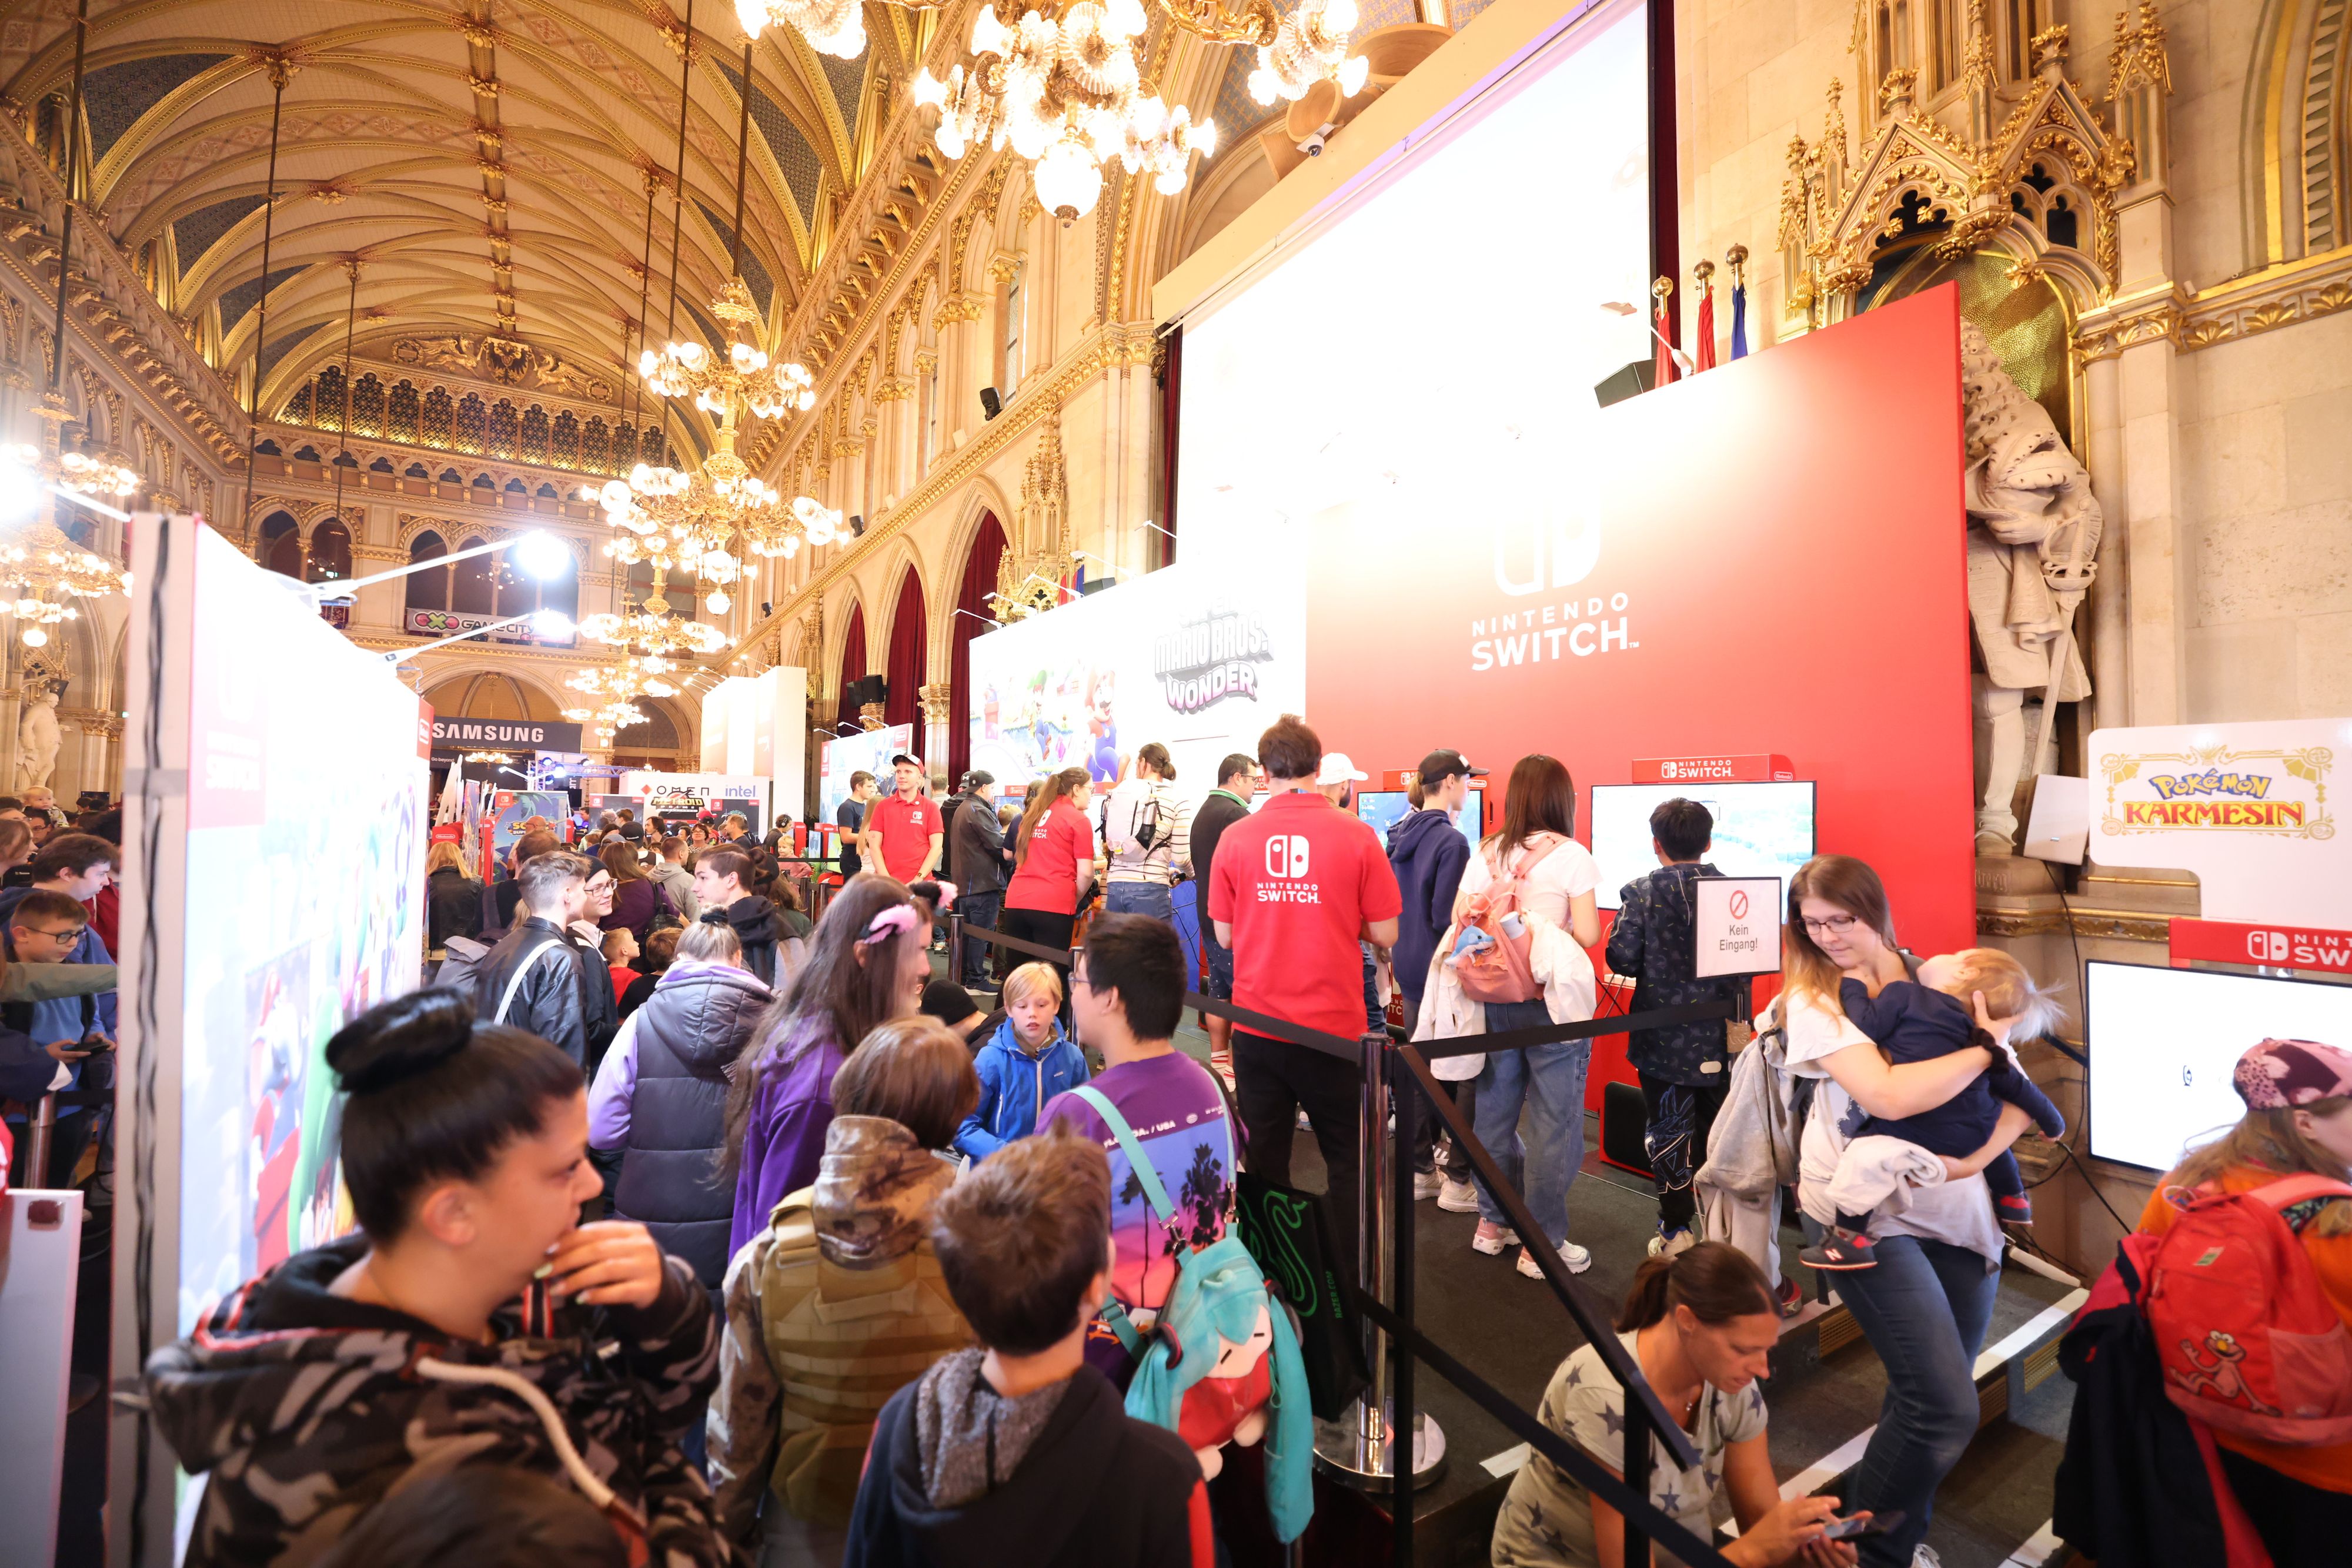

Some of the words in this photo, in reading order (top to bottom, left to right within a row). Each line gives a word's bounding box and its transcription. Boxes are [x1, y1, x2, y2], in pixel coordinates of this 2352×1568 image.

[1472, 592, 1628, 637] NINTENDO
[1472, 617, 1627, 671] SWITCH
[1166, 660, 1257, 711] WONDER
[432, 723, 544, 743] SAMSUNG
[1679, 767, 1731, 778] SWITCH
[2123, 802, 2305, 826] KARMESIN
[1257, 882, 1318, 891] NINTENDO
[1258, 891, 1318, 904] SWITCH
[1729, 925, 1749, 935] Kein
[1720, 938, 1758, 952] Eingang!
[1156, 1119, 1176, 1132] USA
